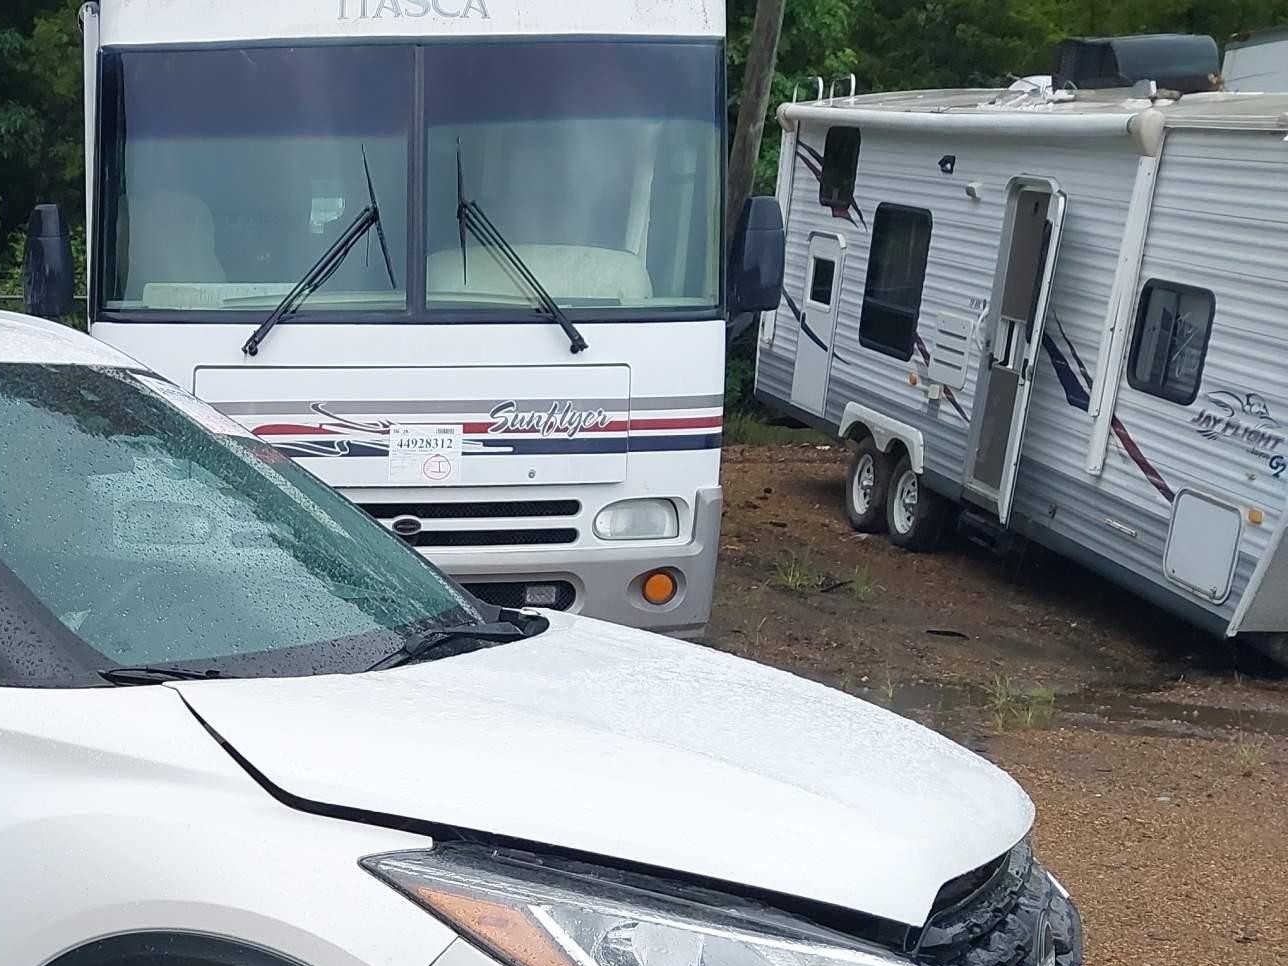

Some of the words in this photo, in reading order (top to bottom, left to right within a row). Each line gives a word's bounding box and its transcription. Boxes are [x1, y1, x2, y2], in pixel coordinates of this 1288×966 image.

[488, 399, 613, 438] Sunflyer
[1191, 408, 1224, 428] JAY
[397, 438, 453, 449] 44928312
